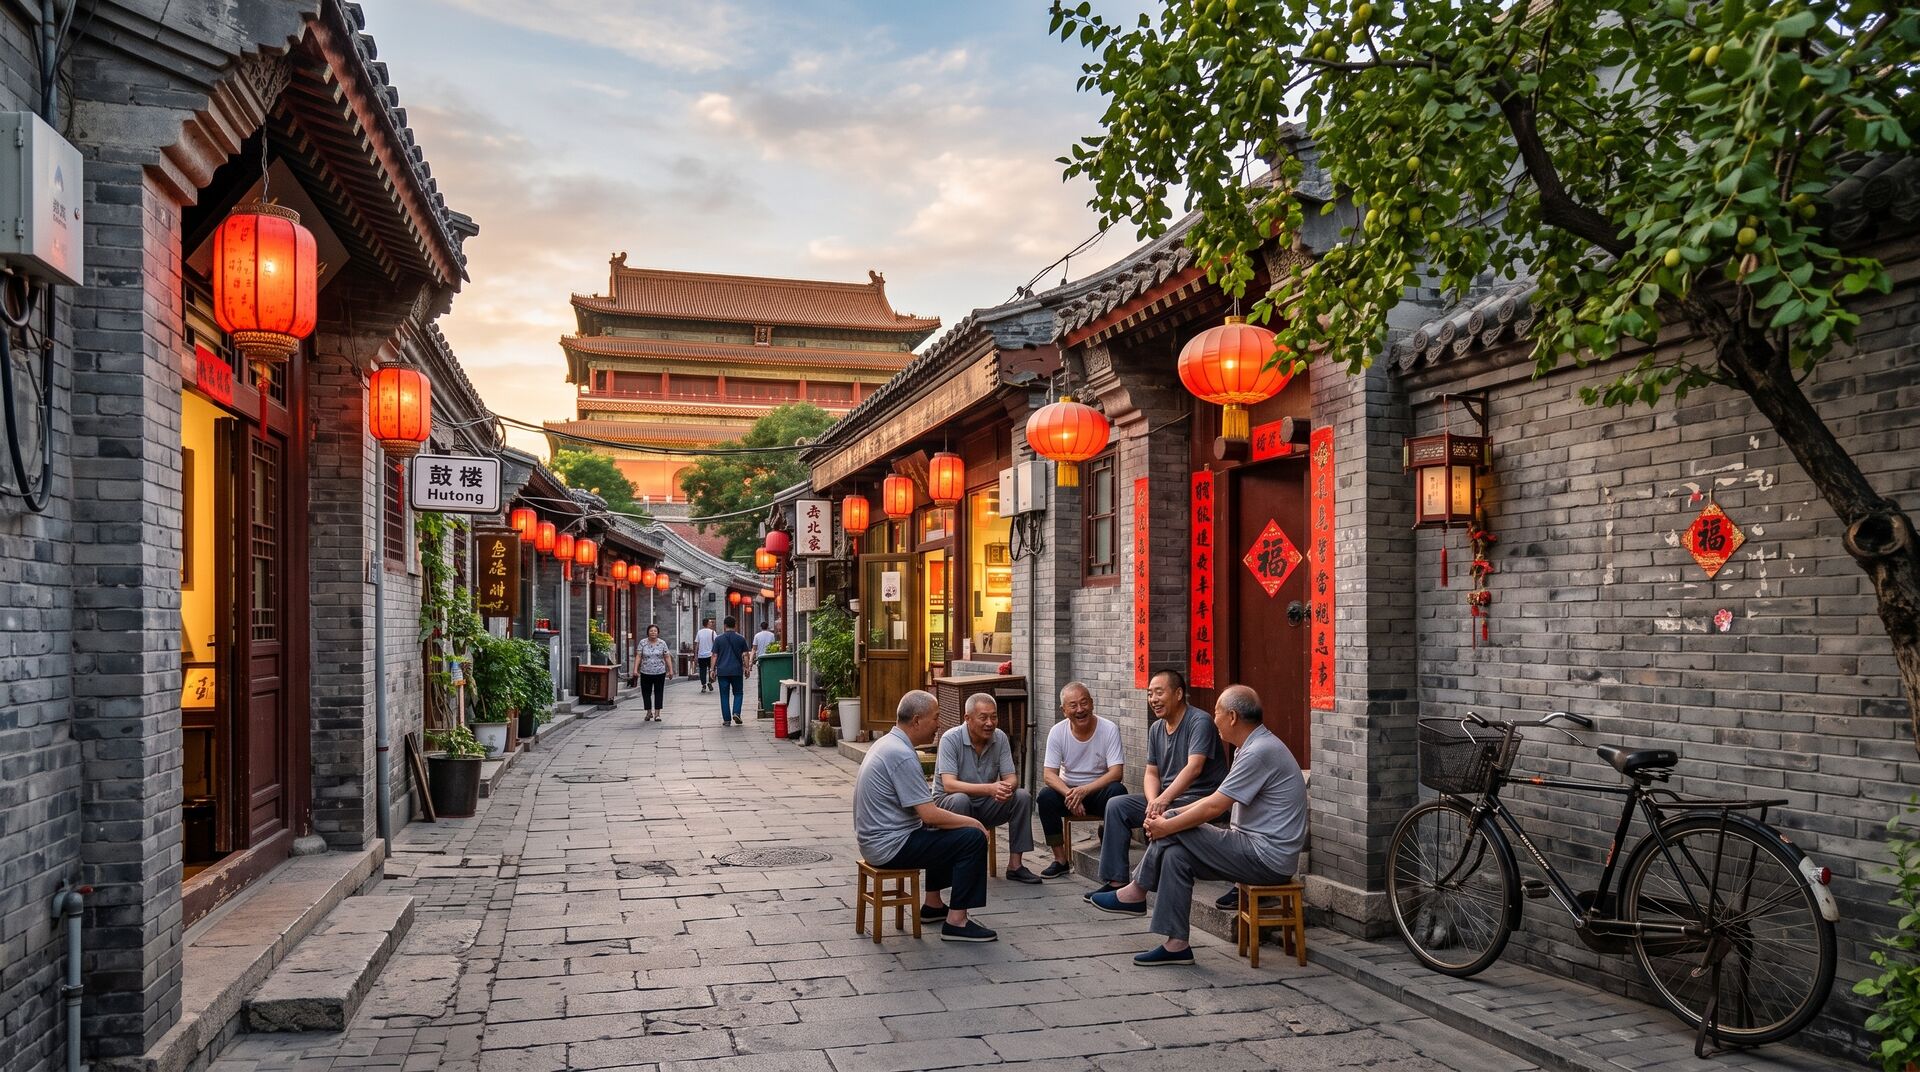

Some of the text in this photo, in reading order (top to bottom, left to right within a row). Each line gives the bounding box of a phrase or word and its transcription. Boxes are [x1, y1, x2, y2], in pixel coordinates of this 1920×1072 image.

[429, 465, 483, 488] 鼓楼
[428, 488, 484, 505] Hutong
[1698, 519, 1725, 551] 福
[1257, 538, 1288, 578] 福
